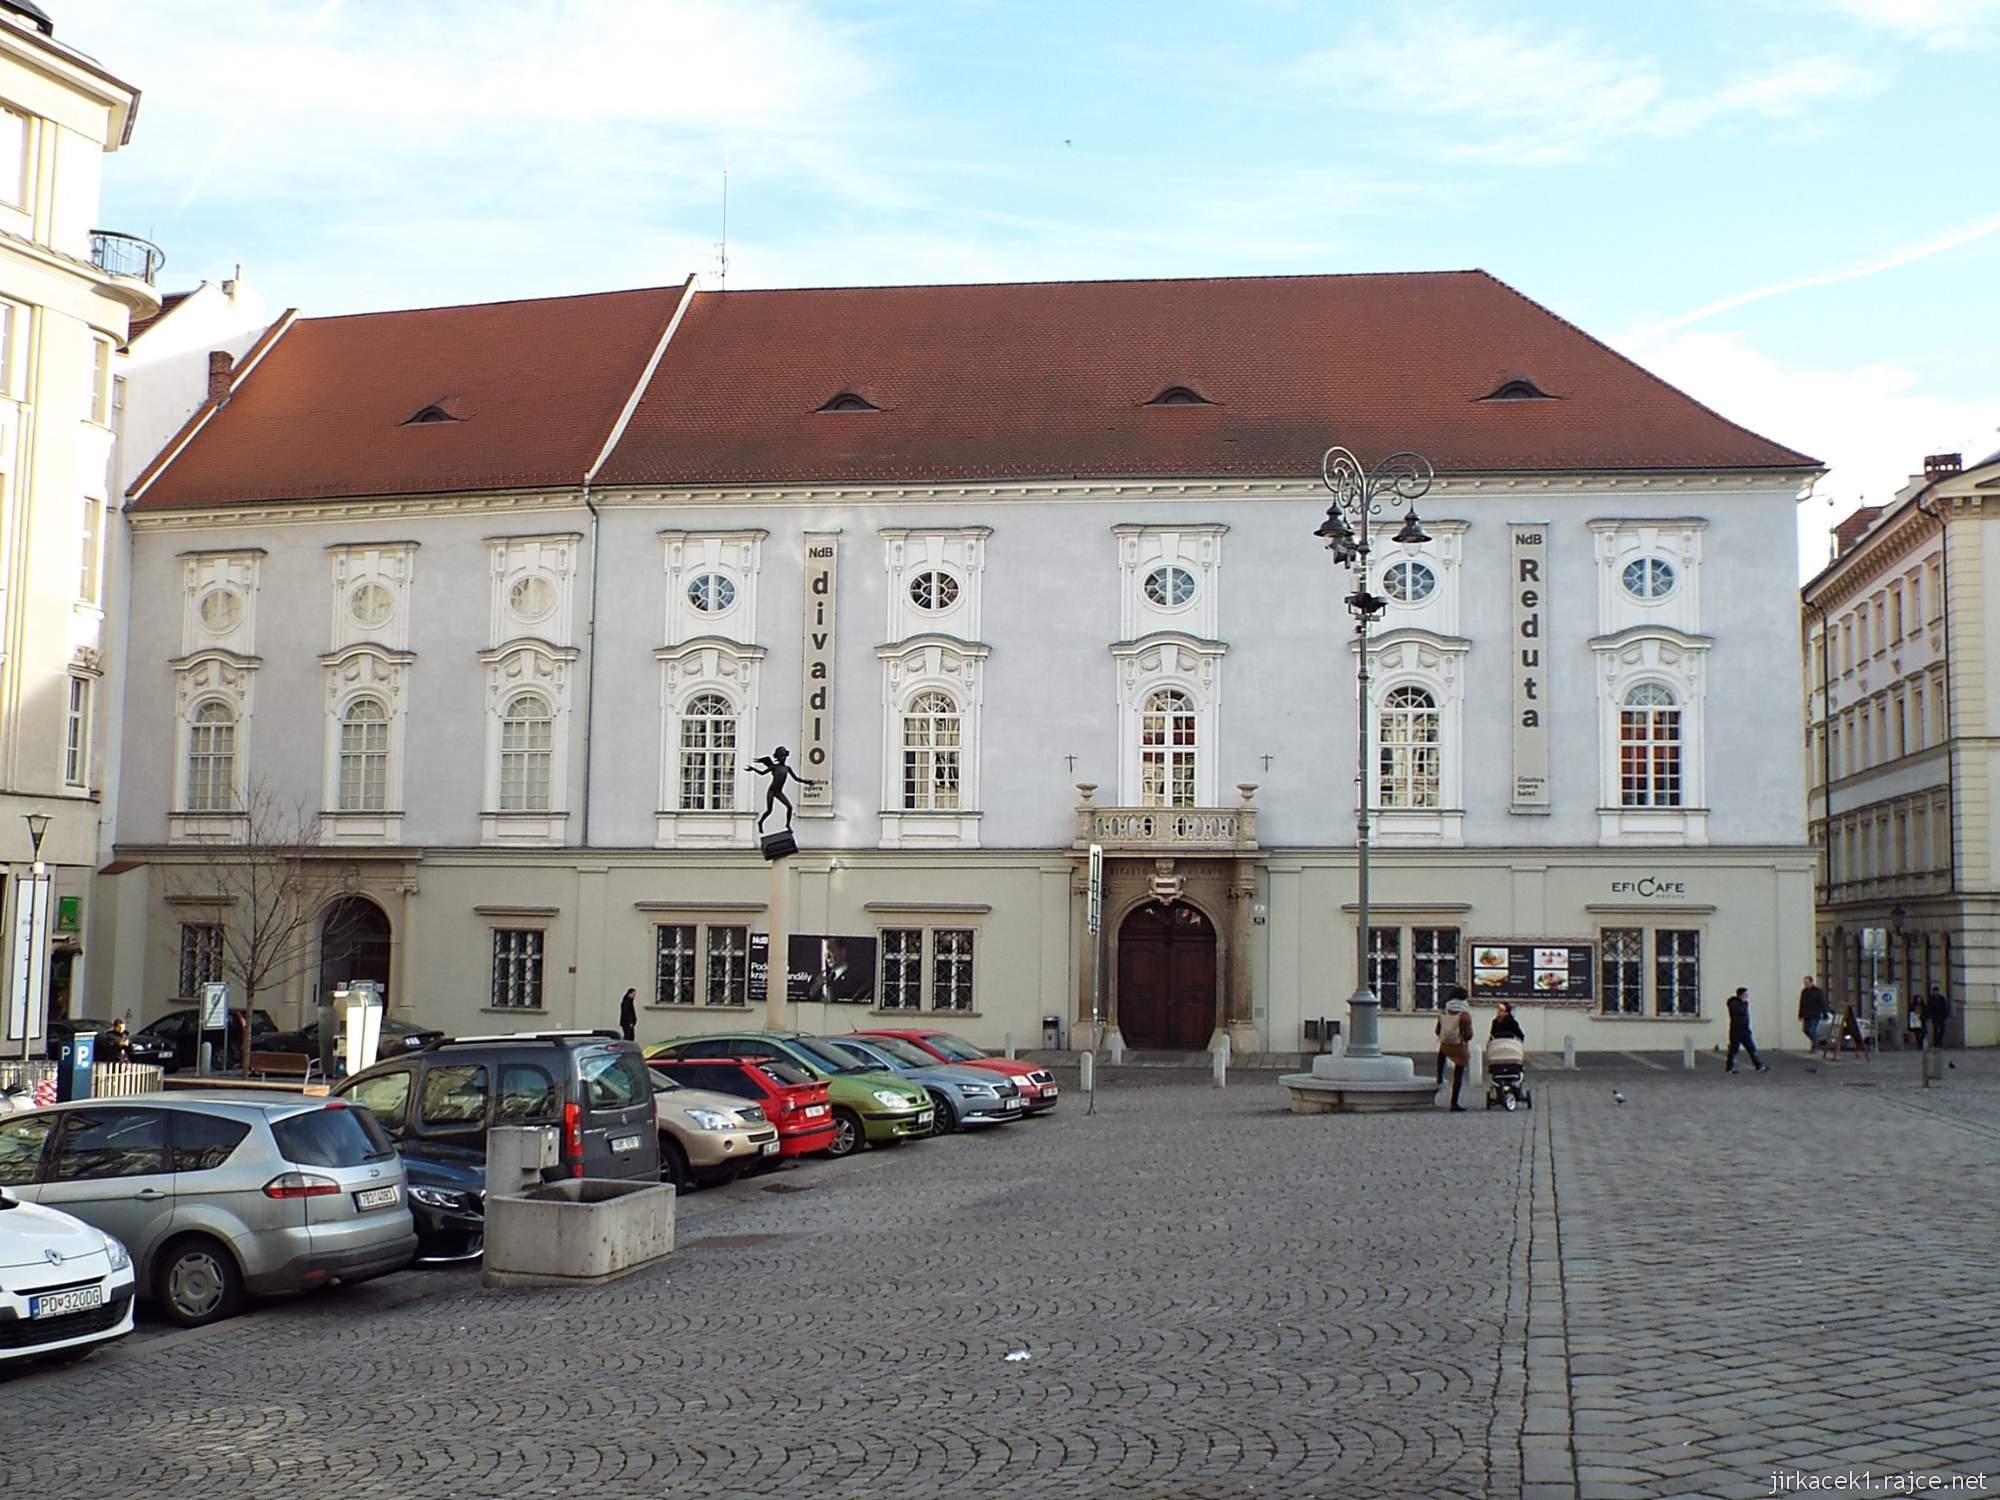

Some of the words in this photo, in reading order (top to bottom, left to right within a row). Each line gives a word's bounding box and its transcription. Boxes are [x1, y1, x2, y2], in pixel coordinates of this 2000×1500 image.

[1515, 534, 1543, 545] NdB
[808, 547, 834, 559] NdB
[1519, 559, 1540, 728] Reduta
[809, 571, 829, 765] divadlo
[61, 1046, 71, 1061] P
